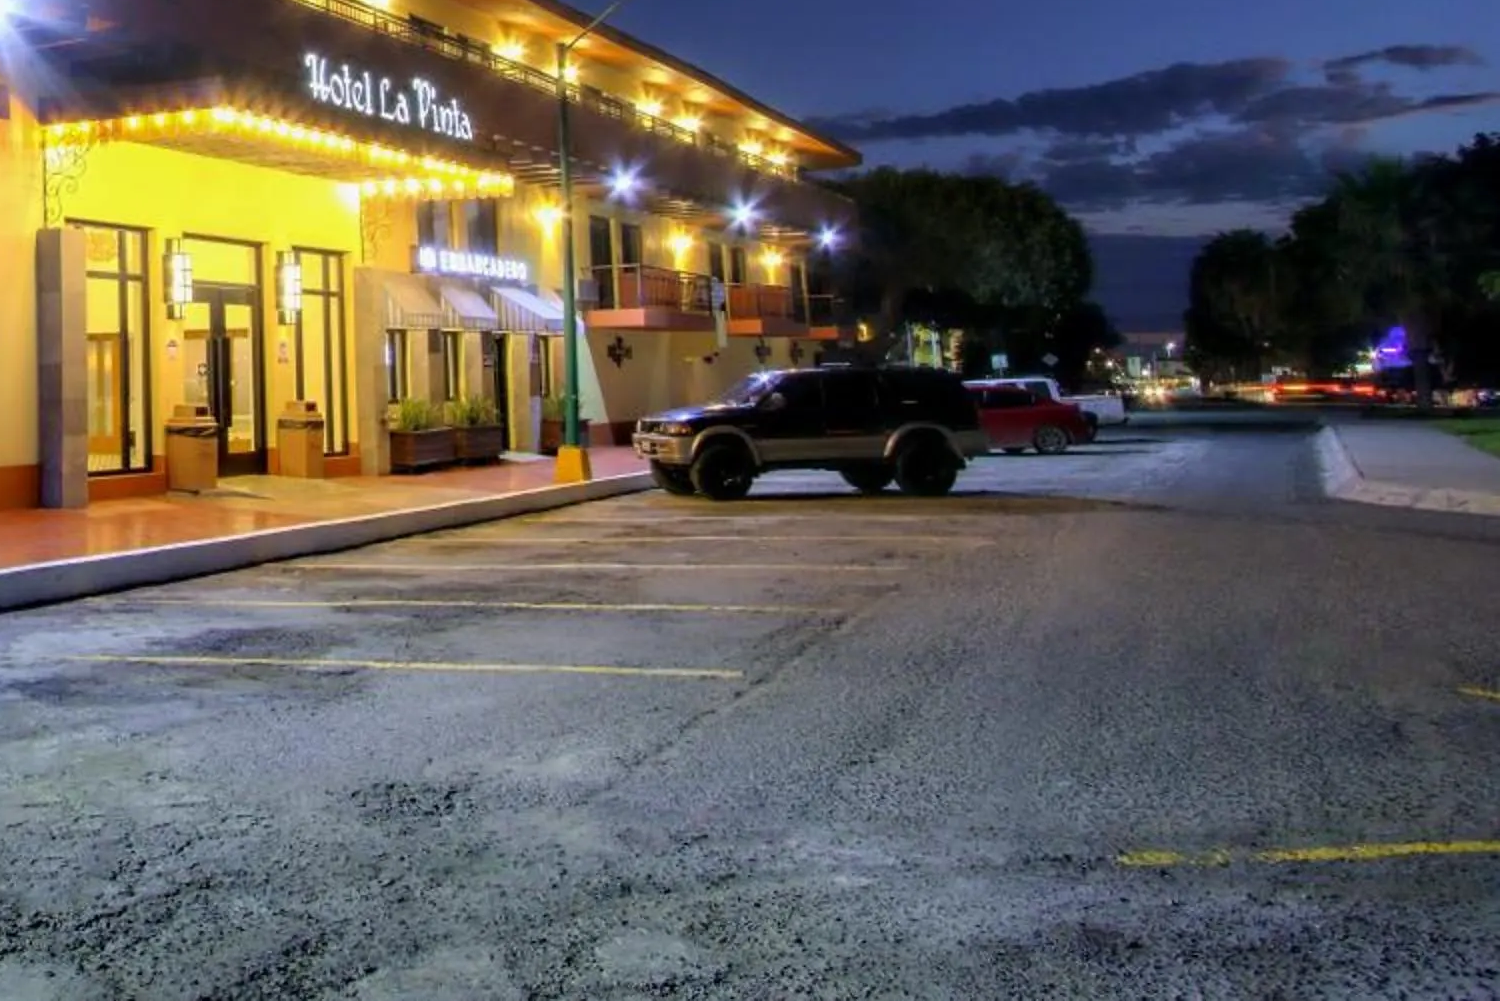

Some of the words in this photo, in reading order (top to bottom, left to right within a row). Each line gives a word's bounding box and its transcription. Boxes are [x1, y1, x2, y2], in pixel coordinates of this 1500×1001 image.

[303, 52, 374, 117] Hotel
[379, 76, 410, 125] La
[411, 76, 473, 141] Pinta
